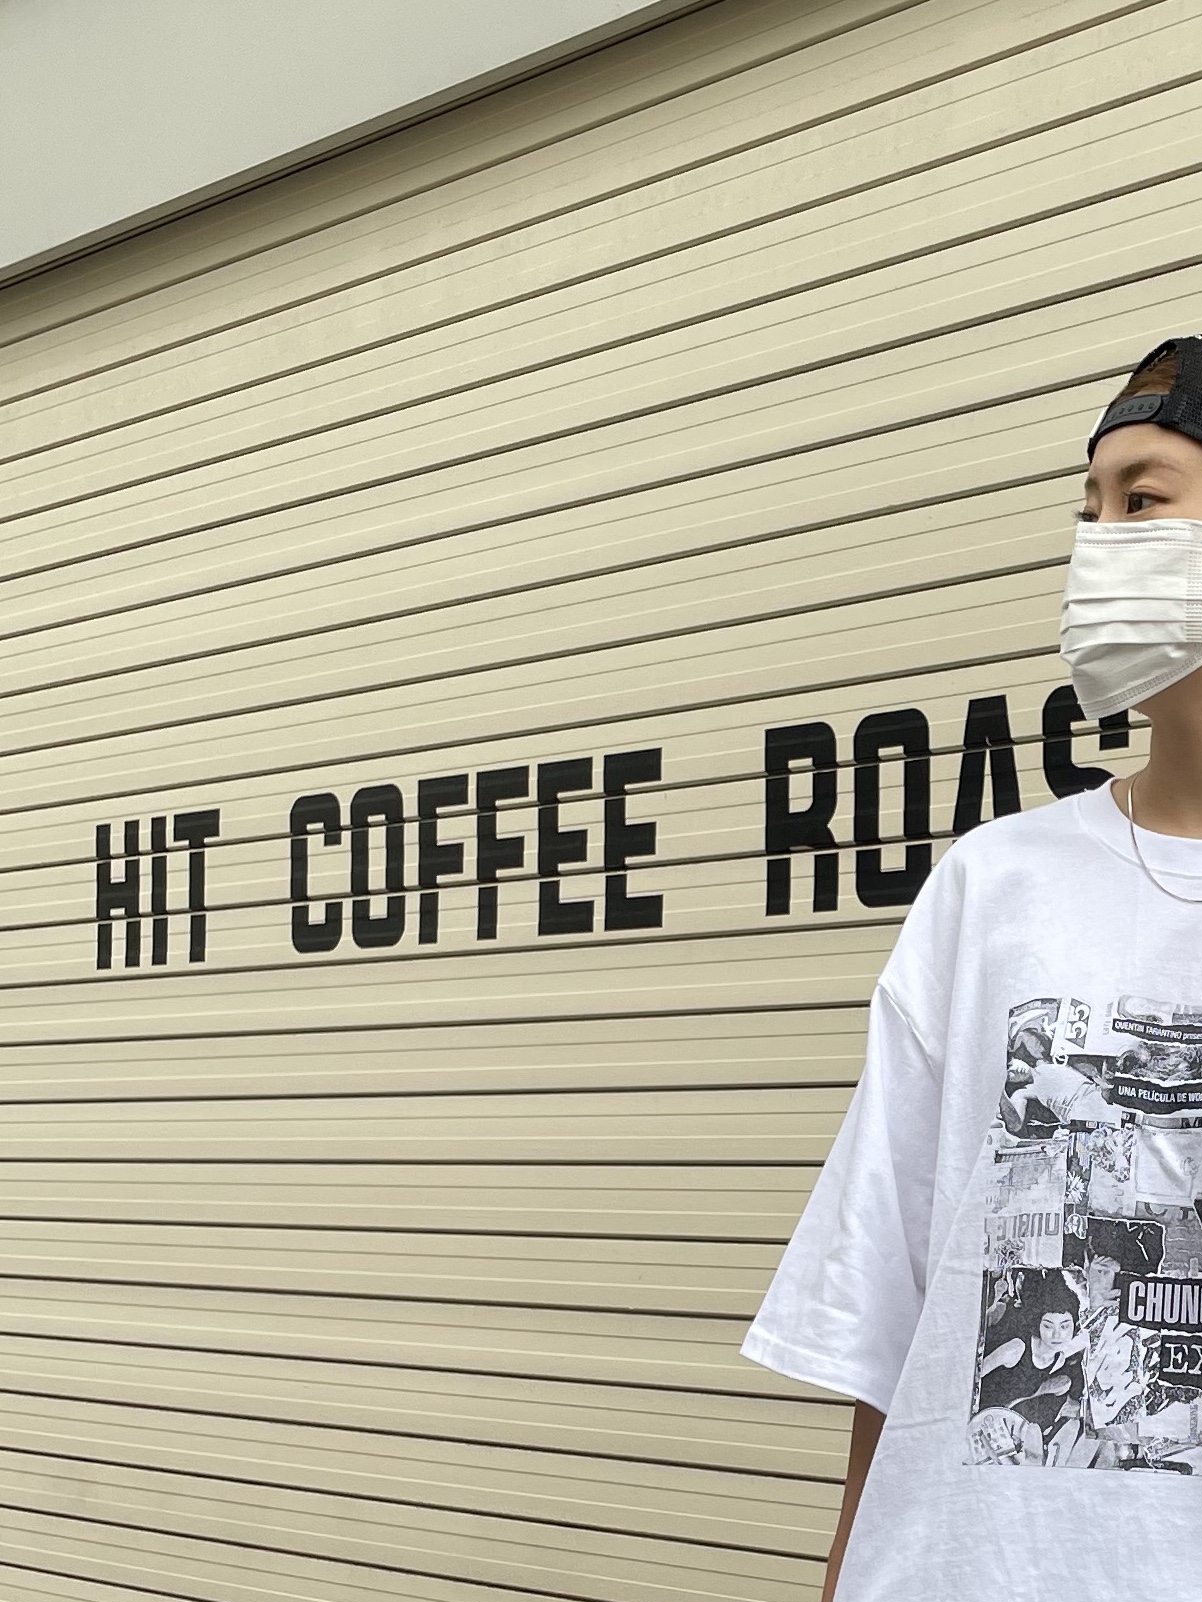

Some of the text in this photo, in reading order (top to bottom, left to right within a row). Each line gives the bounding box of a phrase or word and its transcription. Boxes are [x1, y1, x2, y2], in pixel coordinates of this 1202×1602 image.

[96, 808, 221, 971] HIT
[290, 747, 664, 954] COFFEE
[1114, 1020, 1145, 1033] QUENTIN
[1145, 1025, 1182, 1039] TARANTINO
[1118, 1085, 1137, 1098] UNA
[1138, 1088, 1176, 1103] PELÍCULA
[1176, 1092, 1187, 1102] DE
